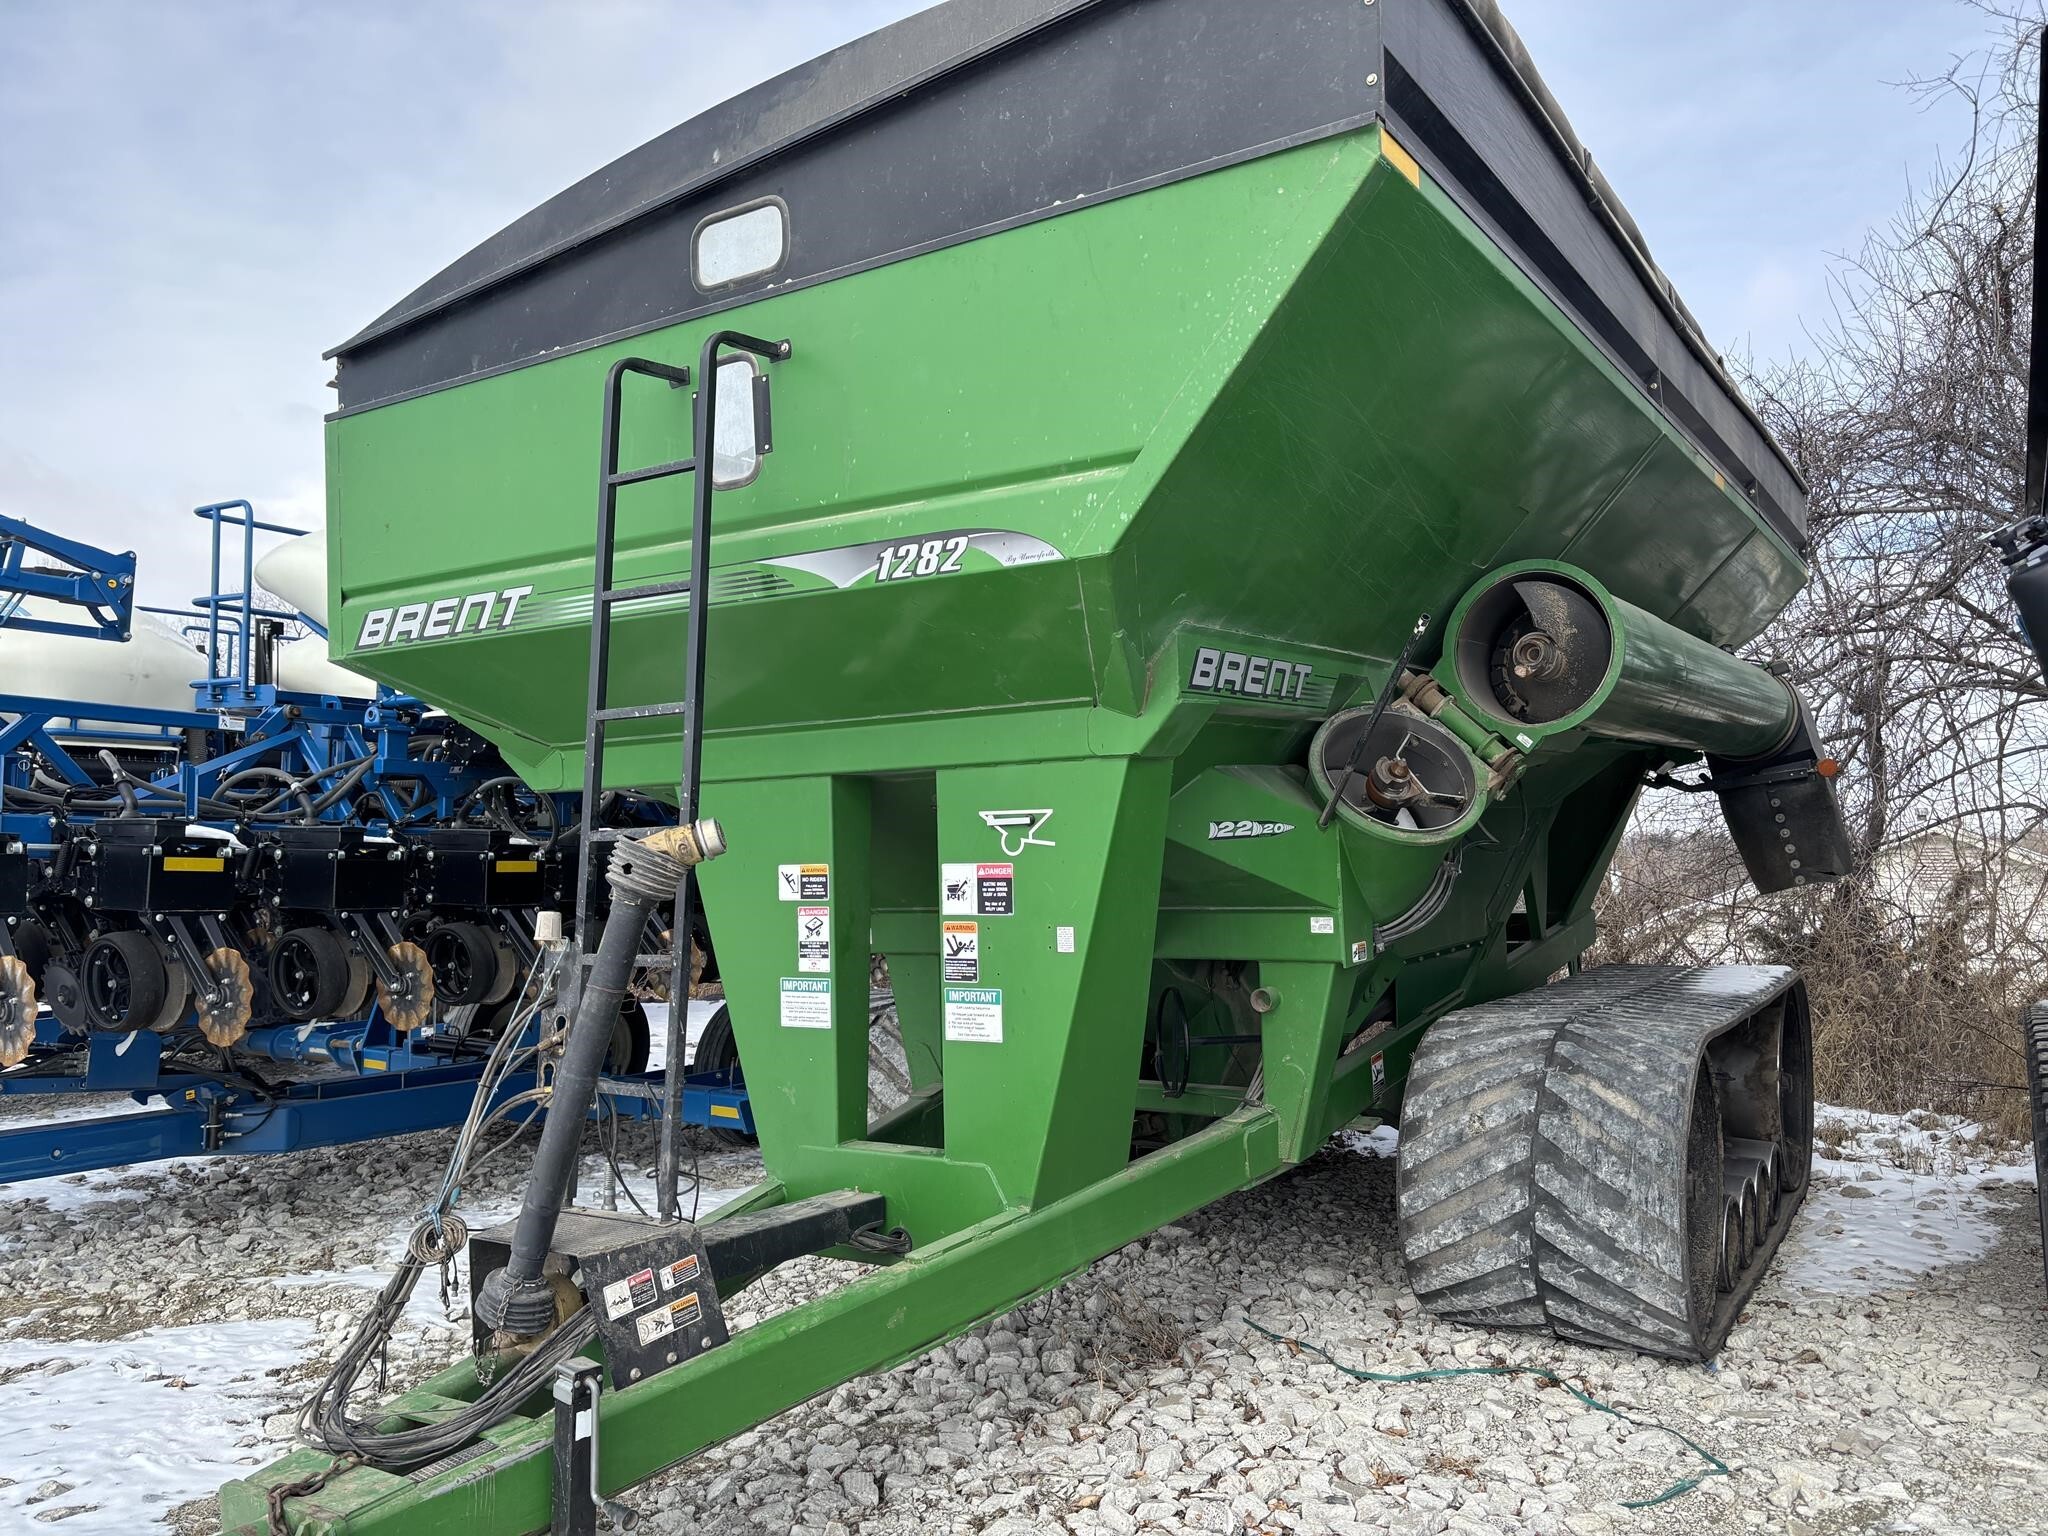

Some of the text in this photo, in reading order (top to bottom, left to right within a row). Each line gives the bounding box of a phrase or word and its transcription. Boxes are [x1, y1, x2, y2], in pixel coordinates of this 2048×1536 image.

[876, 536, 969, 583] 1282
[356, 585, 534, 649] BRENT
[1189, 647, 1313, 701] BRENT
[985, 867, 1012, 875] DANGER
[783, 980, 829, 992] IMPORTANT
[949, 990, 997, 1003] IMPORTANT
